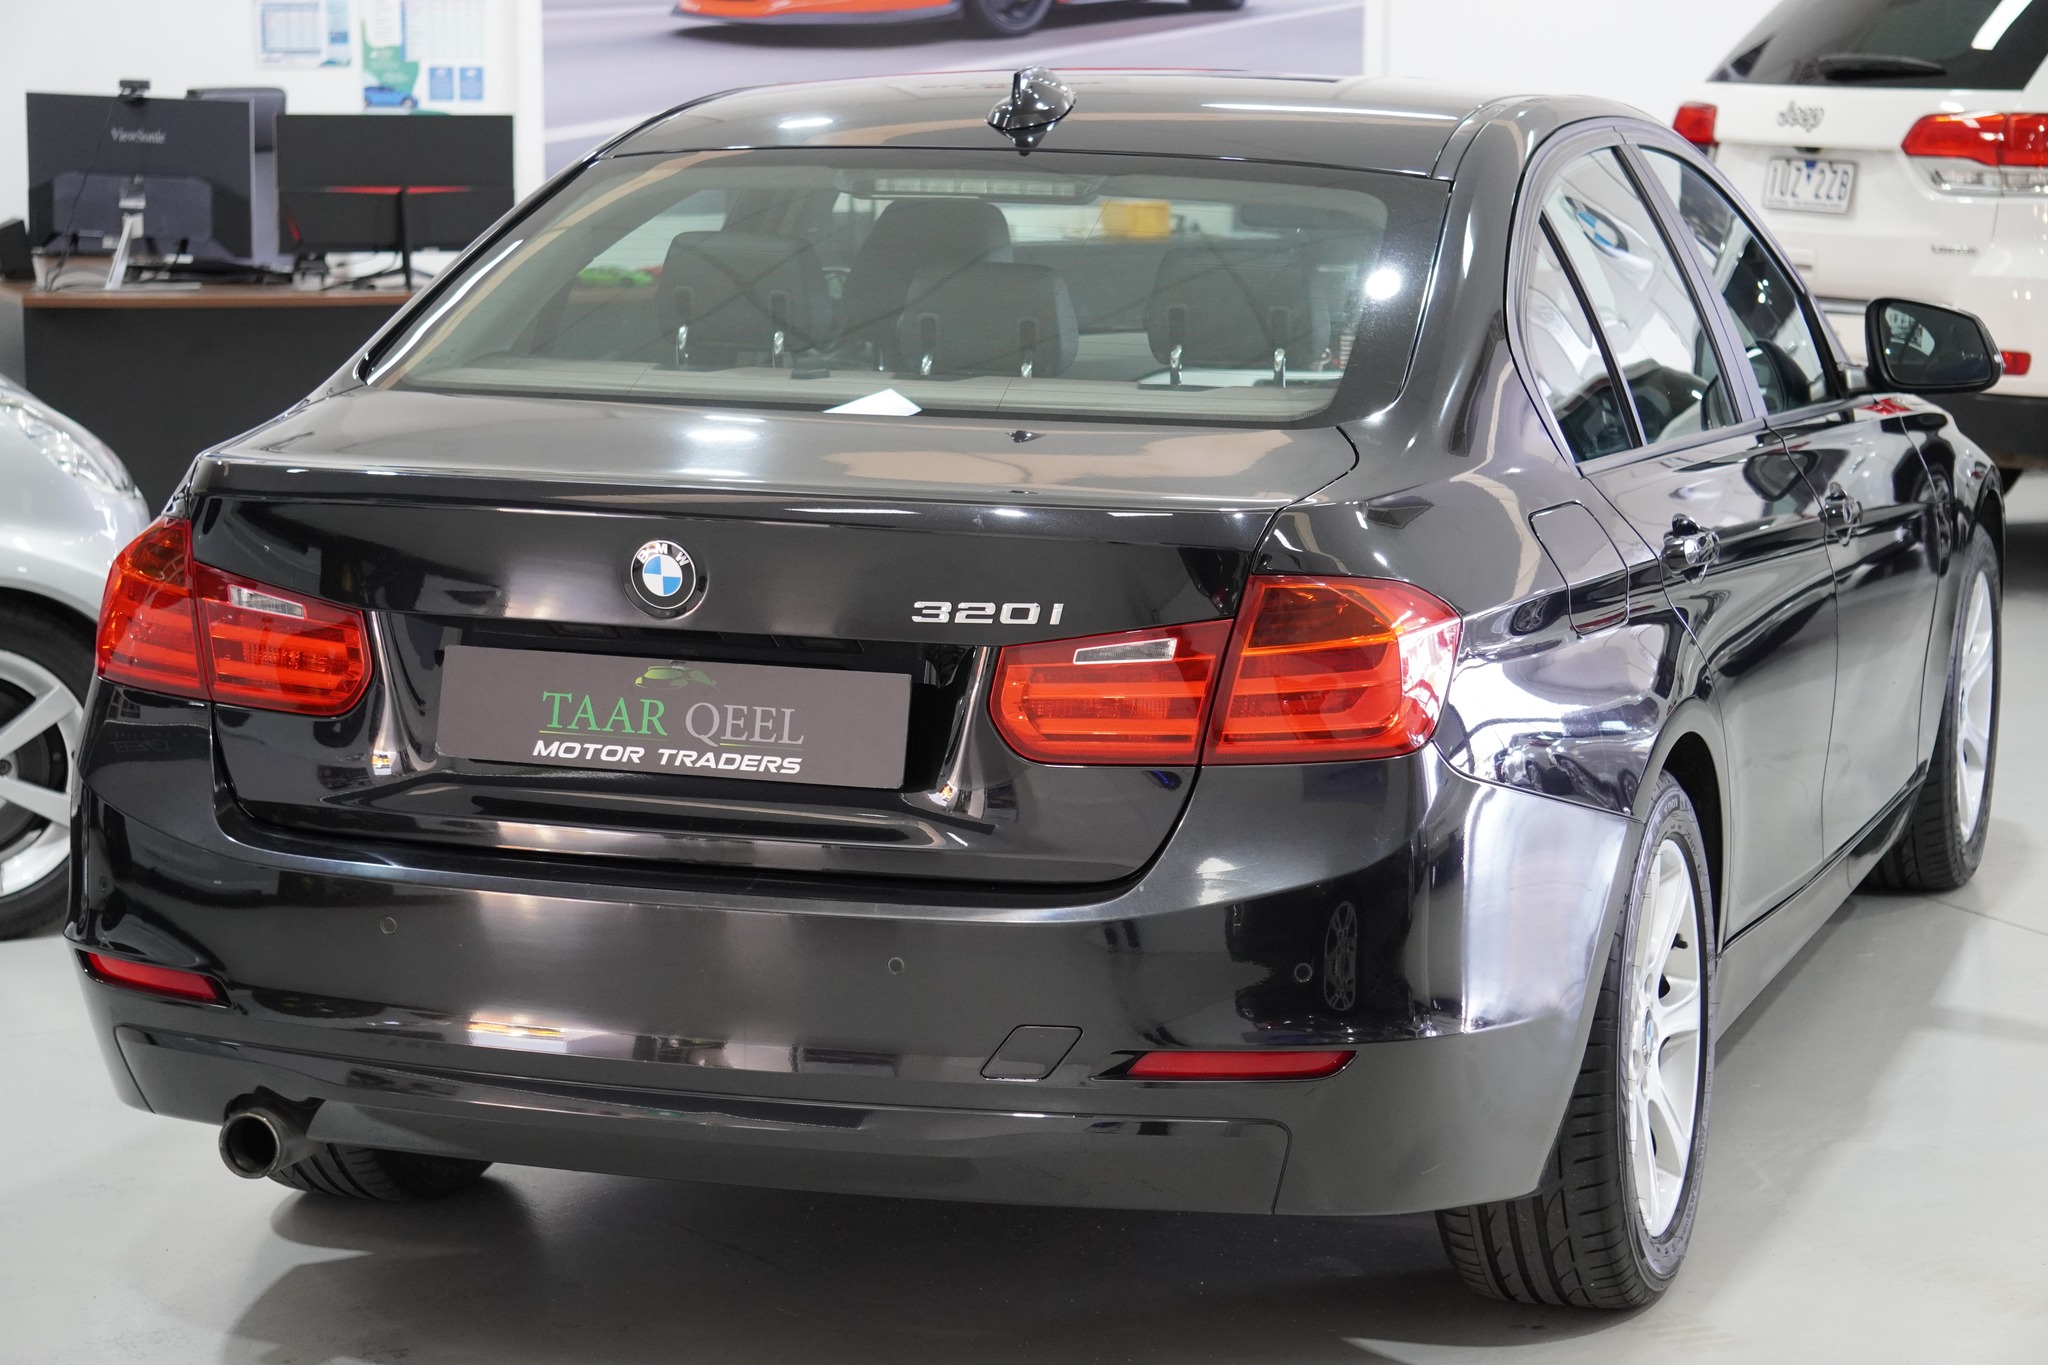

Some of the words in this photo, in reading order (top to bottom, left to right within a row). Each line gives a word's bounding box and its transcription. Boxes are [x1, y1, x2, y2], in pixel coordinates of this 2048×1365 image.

[1776, 100, 1825, 133] Jeep
[111, 127, 167, 144] ViewSonic
[637, 542, 690, 567] BMW
[542, 691, 668, 736] TAAR
[685, 702, 805, 747] QEEL
[532, 740, 645, 764] MOTOR
[658, 748, 803, 774] TRADERS
